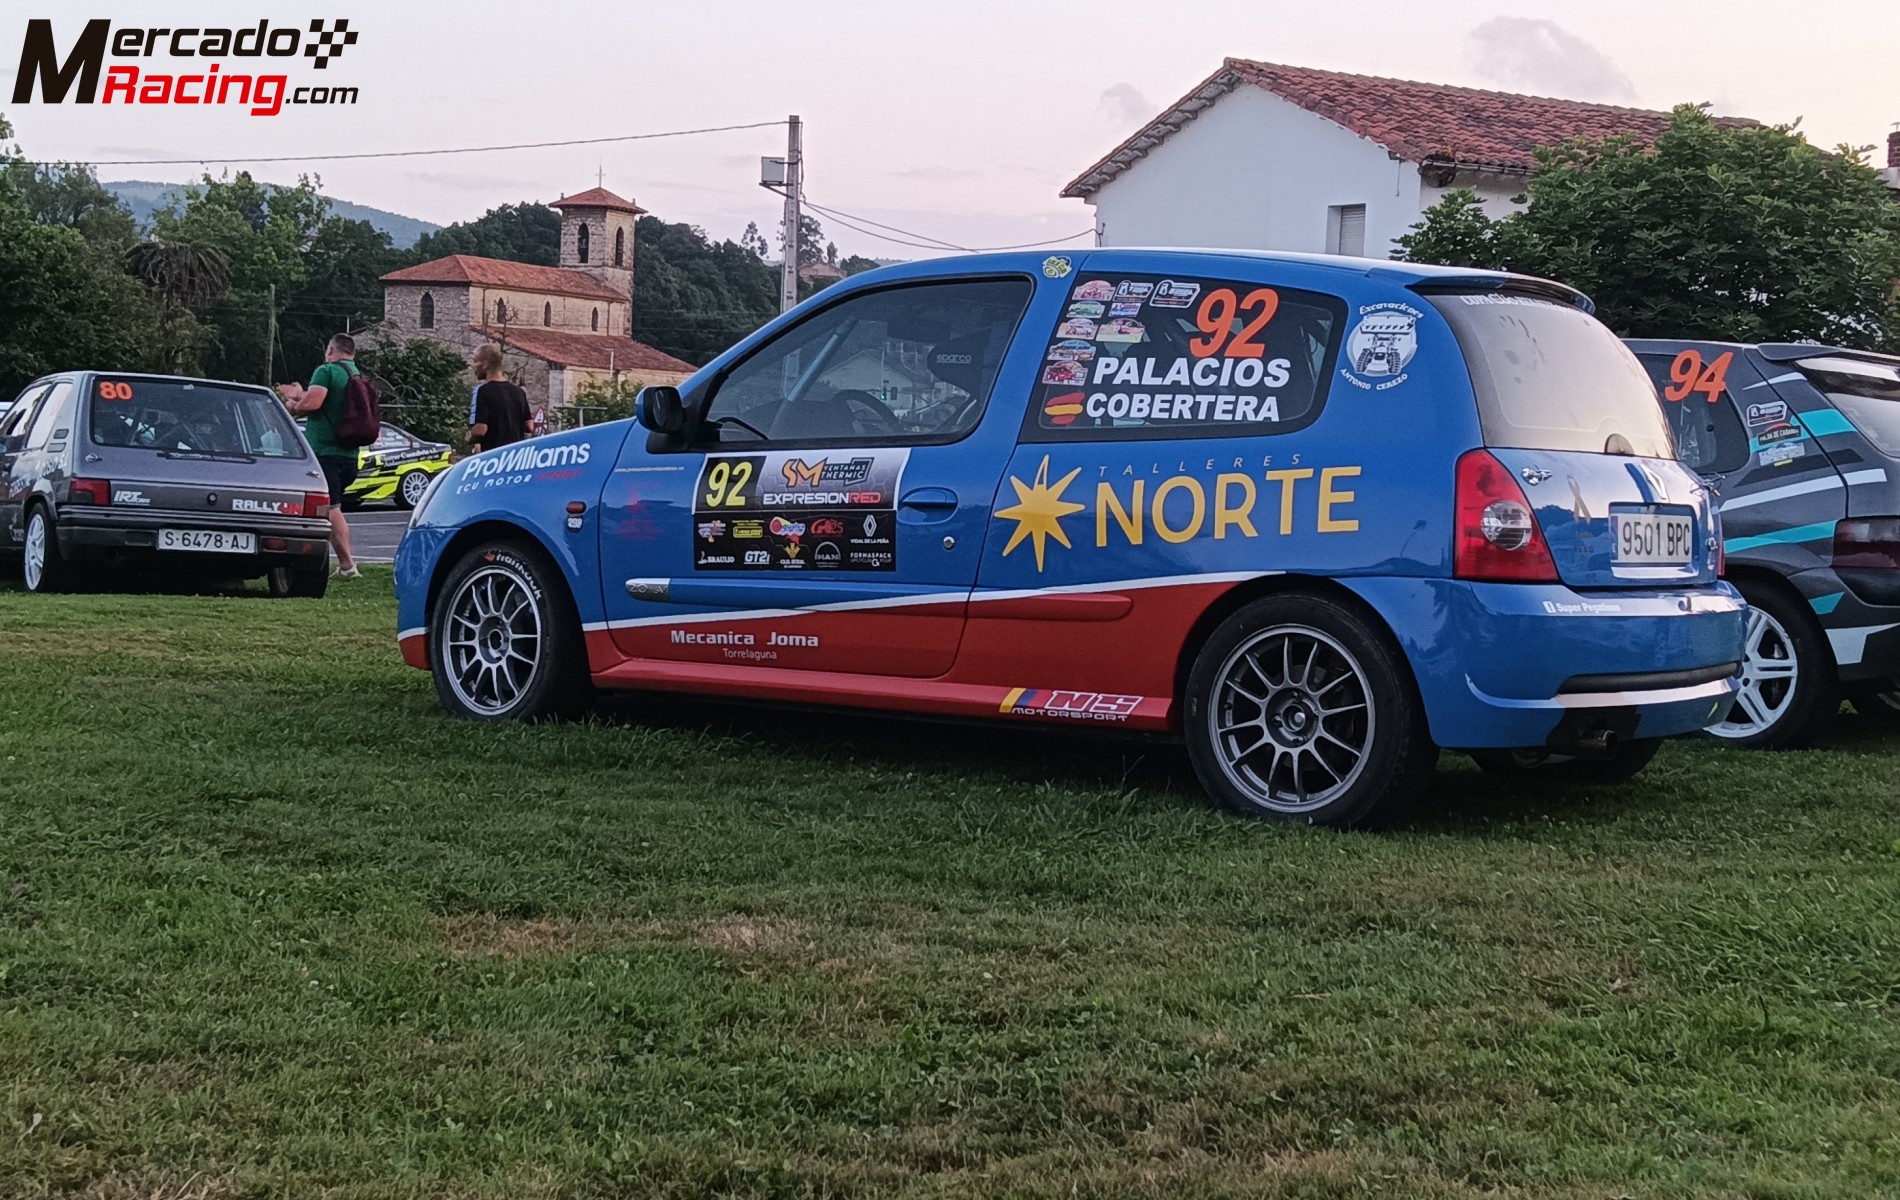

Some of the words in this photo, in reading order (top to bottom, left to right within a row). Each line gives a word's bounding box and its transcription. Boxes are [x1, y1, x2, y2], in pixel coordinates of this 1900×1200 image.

[1190, 288, 1279, 358] 92
[936, 354, 972, 363] sparco
[1092, 357, 1291, 388] PALACIOS
[1340, 368, 1371, 390] ANTONIO
[1376, 373, 1408, 390] CEREZO
[1664, 349, 1733, 404] 94
[99, 381, 133, 401] 80
[1087, 393, 1280, 422] COBERTERA
[461, 443, 590, 481] ProWilliams
[782, 457, 828, 488] SM
[824, 464, 867, 472] VENTANAS
[1099, 454, 1300, 478] TALLERES
[456, 481, 480, 495] ECU
[484, 474, 533, 487] MOTOR
[705, 461, 752, 508] 92
[821, 471, 864, 479] THERMIC
[1096, 466, 1362, 547] NORTE
[164, 531, 250, 550] S-6478-AJ
[1622, 521, 1661, 556] 9501
[1667, 522, 1691, 557] BPC
[1556, 602, 1581, 614] Super
[671, 630, 755, 645] Mecanica
[767, 631, 818, 647] Joma
[723, 648, 777, 661] Torrelaguna
[1044, 690, 1144, 715] NS
[1011, 707, 1128, 722] MOTORSPORT
